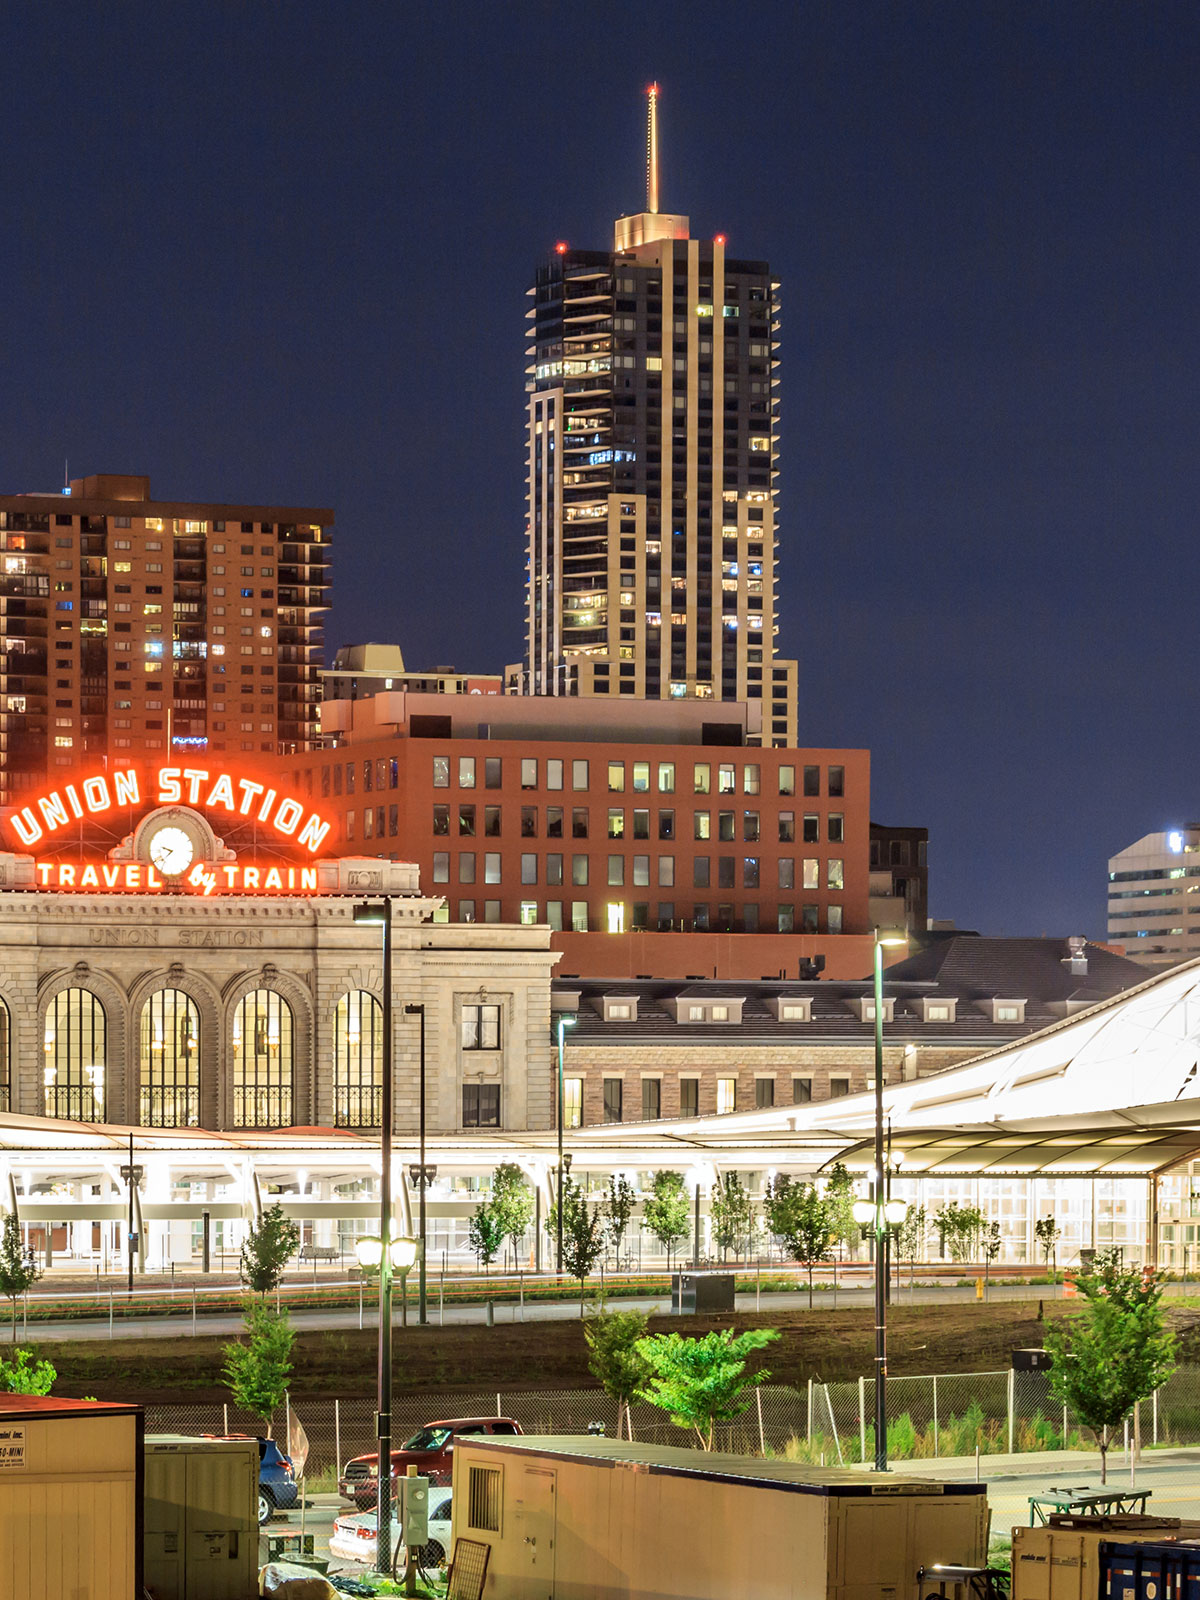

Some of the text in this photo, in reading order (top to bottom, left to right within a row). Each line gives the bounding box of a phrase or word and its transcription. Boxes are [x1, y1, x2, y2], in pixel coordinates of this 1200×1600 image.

[10, 767, 331, 853] UNION STATION
[36, 863, 317, 896] TRAVEL by TRAIN
[88, 929, 264, 946] UNION STATION
